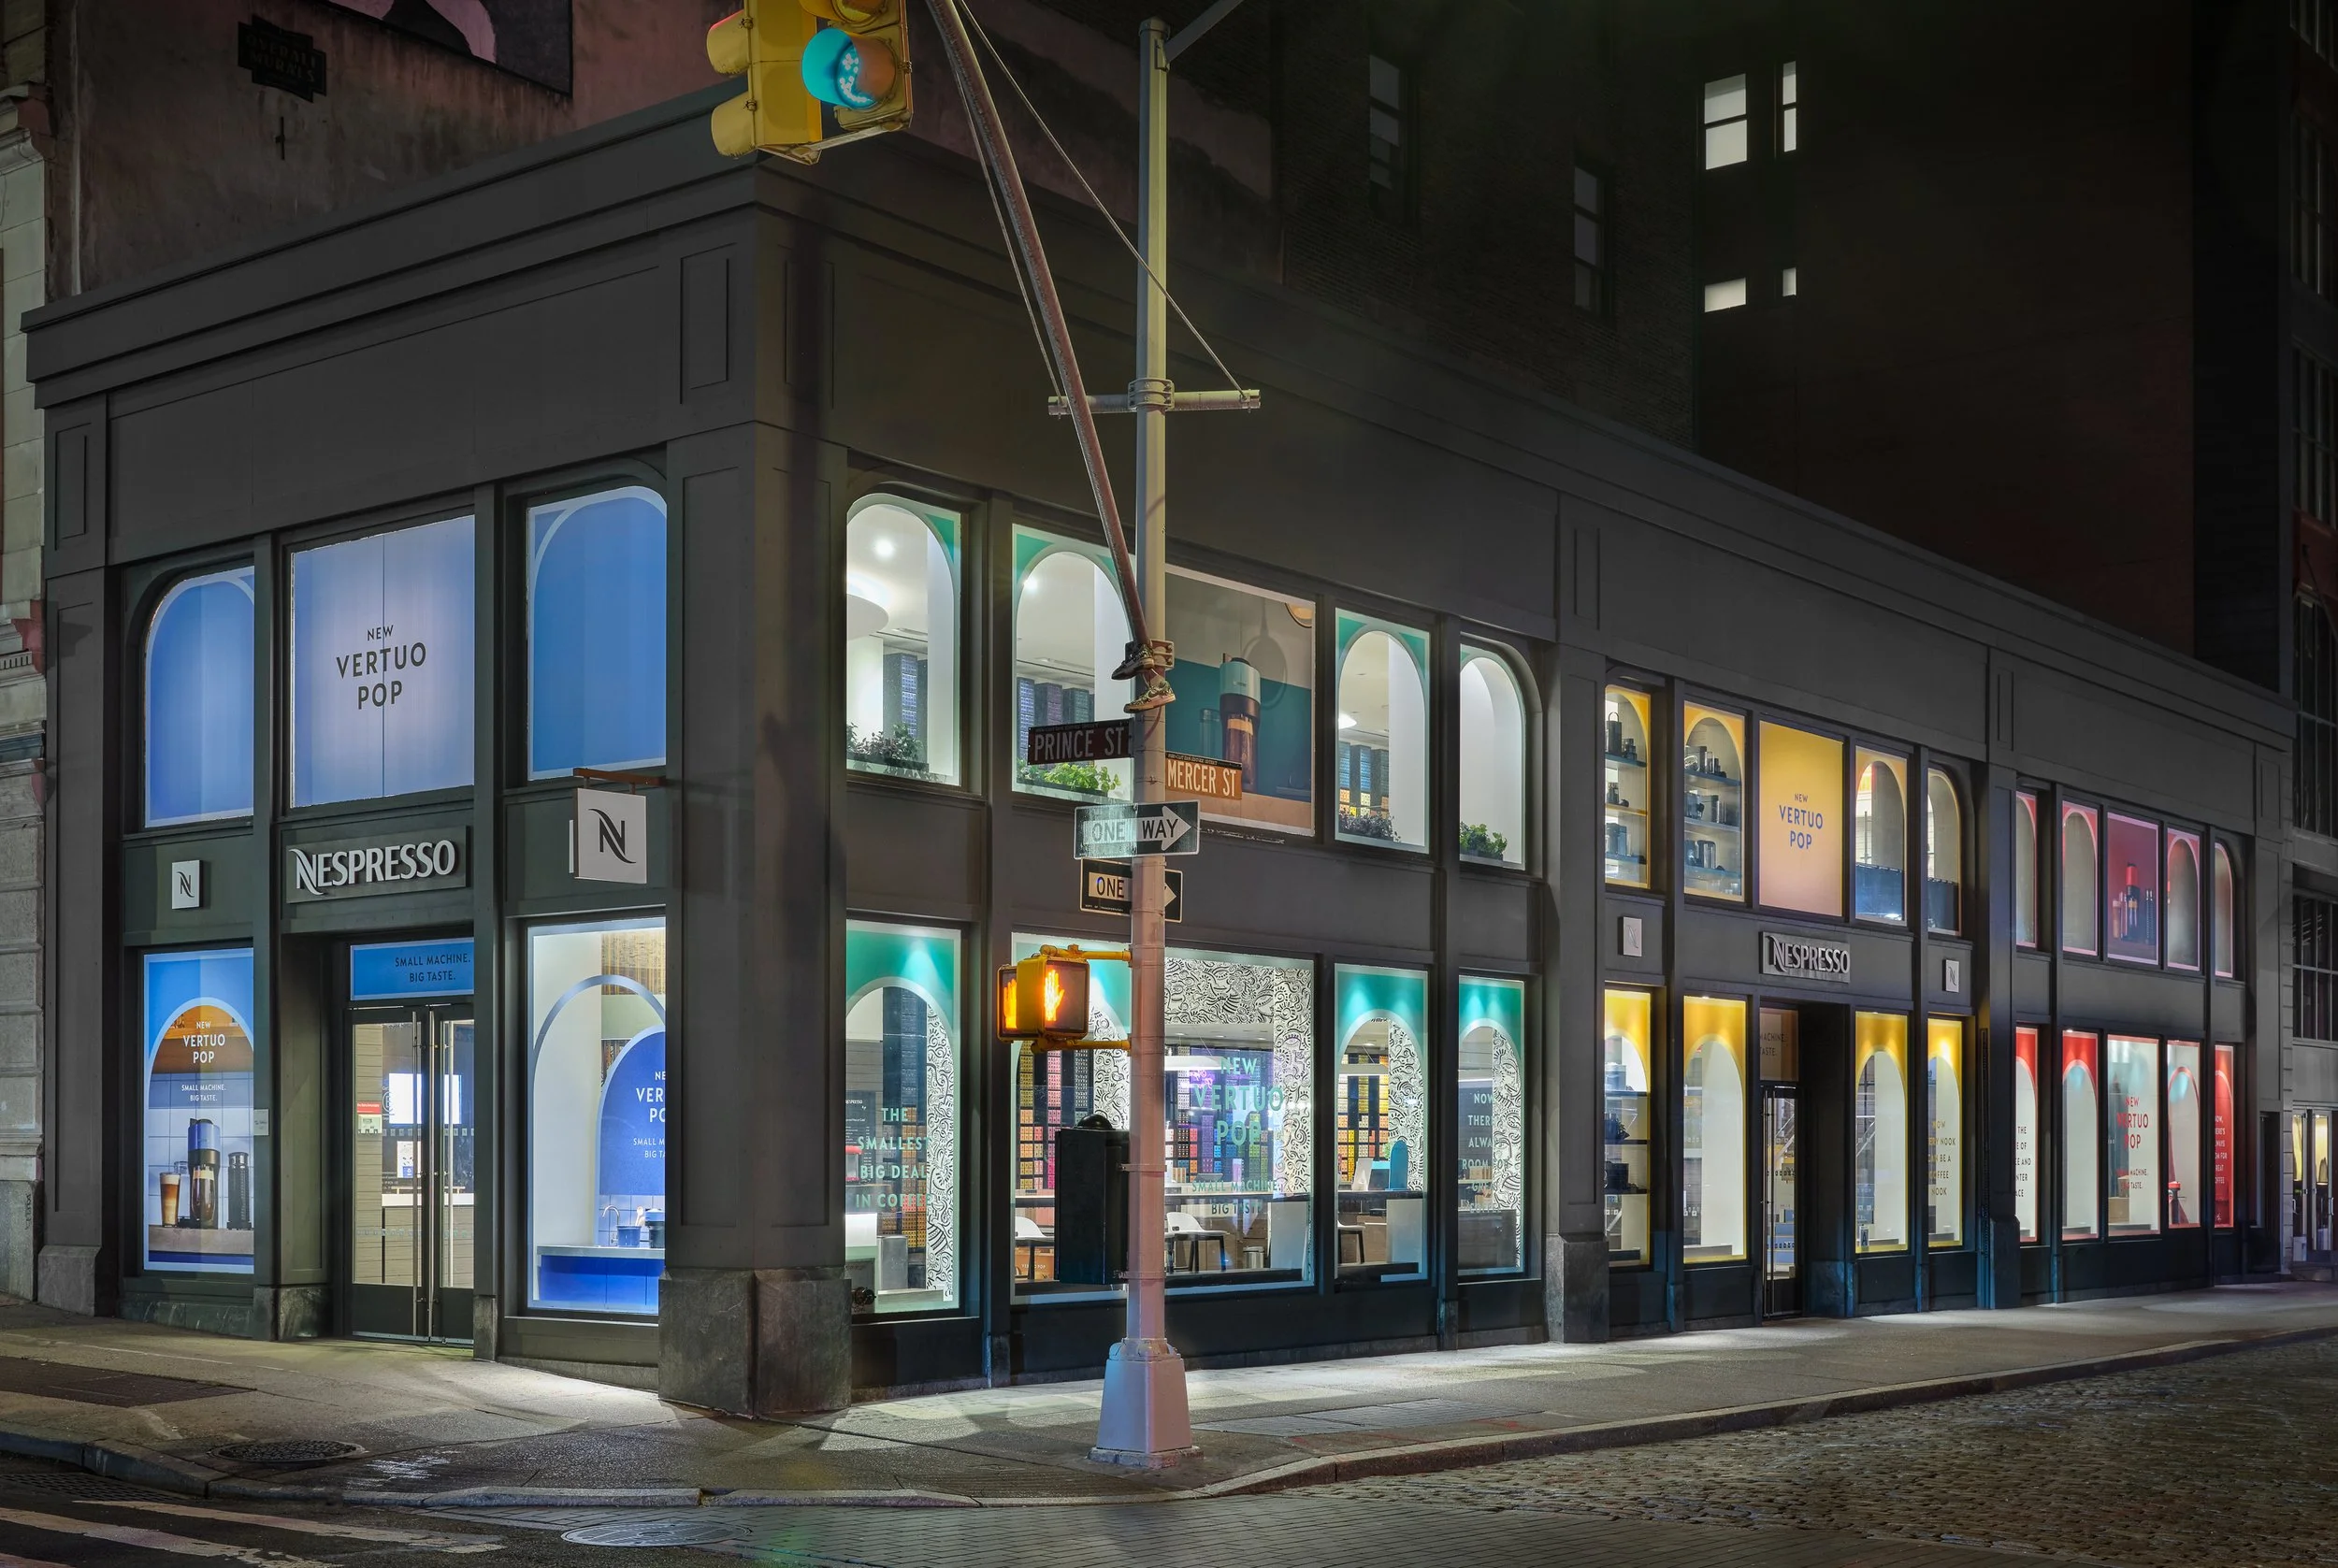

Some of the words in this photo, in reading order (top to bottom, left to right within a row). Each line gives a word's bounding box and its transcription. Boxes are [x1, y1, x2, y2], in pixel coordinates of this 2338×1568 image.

[367, 625, 394, 641] NEW
[336, 642, 426, 679] VERTUO
[358, 681, 402, 710] POP
[1034, 730, 1094, 761] PRINCE
[1104, 726, 1124, 755] ST
[1167, 759, 1217, 794] MERCER
[1222, 768, 1236, 797] ST
[1795, 794, 1808, 802] NEW
[1779, 805, 1823, 829] VERTUO
[587, 808, 636, 864] N
[1092, 822, 1125, 842] ONE
[1142, 818, 1178, 840] WAY
[1790, 830, 1812, 849] POP
[289, 840, 455, 895] NESPRESSO
[1096, 876, 1125, 899] ONE
[395, 957, 424, 967] SMALL
[426, 953, 470, 965] MACHINE.
[1768, 935, 1850, 973] NESPRESSO
[410, 972, 425, 983] BIG
[427, 971, 455, 982] TASTE.
[182, 1033, 225, 1047] VERTUO
[193, 1051, 214, 1063] POP
[1220, 1057, 1258, 1075] NEW
[655, 1071, 666, 1081] NE
[636, 1087, 664, 1102] VER
[1193, 1085, 1284, 1112] VERTUO
[2125, 1097, 2140, 1107] NEW
[649, 1107, 666, 1123] PO
[881, 1107, 908, 1122] THE
[2116, 1112, 2149, 1129] VERTUO
[1217, 1120, 1262, 1146] POP
[858, 1136, 931, 1150] SMALLEST
[1468, 1137, 1493, 1148] ALWA
[1940, 1137, 1956, 1145] NOOK
[2124, 1134, 2141, 1149] POP
[644, 1150, 657, 1158] BIG
[1940, 1154, 1946, 1162] BE
[860, 1165, 886, 1179] BIG
[891, 1165, 928, 1179] DEAL
[1192, 1180, 1226, 1192] SMALL
[1931, 1187, 1947, 1196] NOOK
[856, 1194, 871, 1208] IN
[1211, 1203, 1229, 1214] BIG
